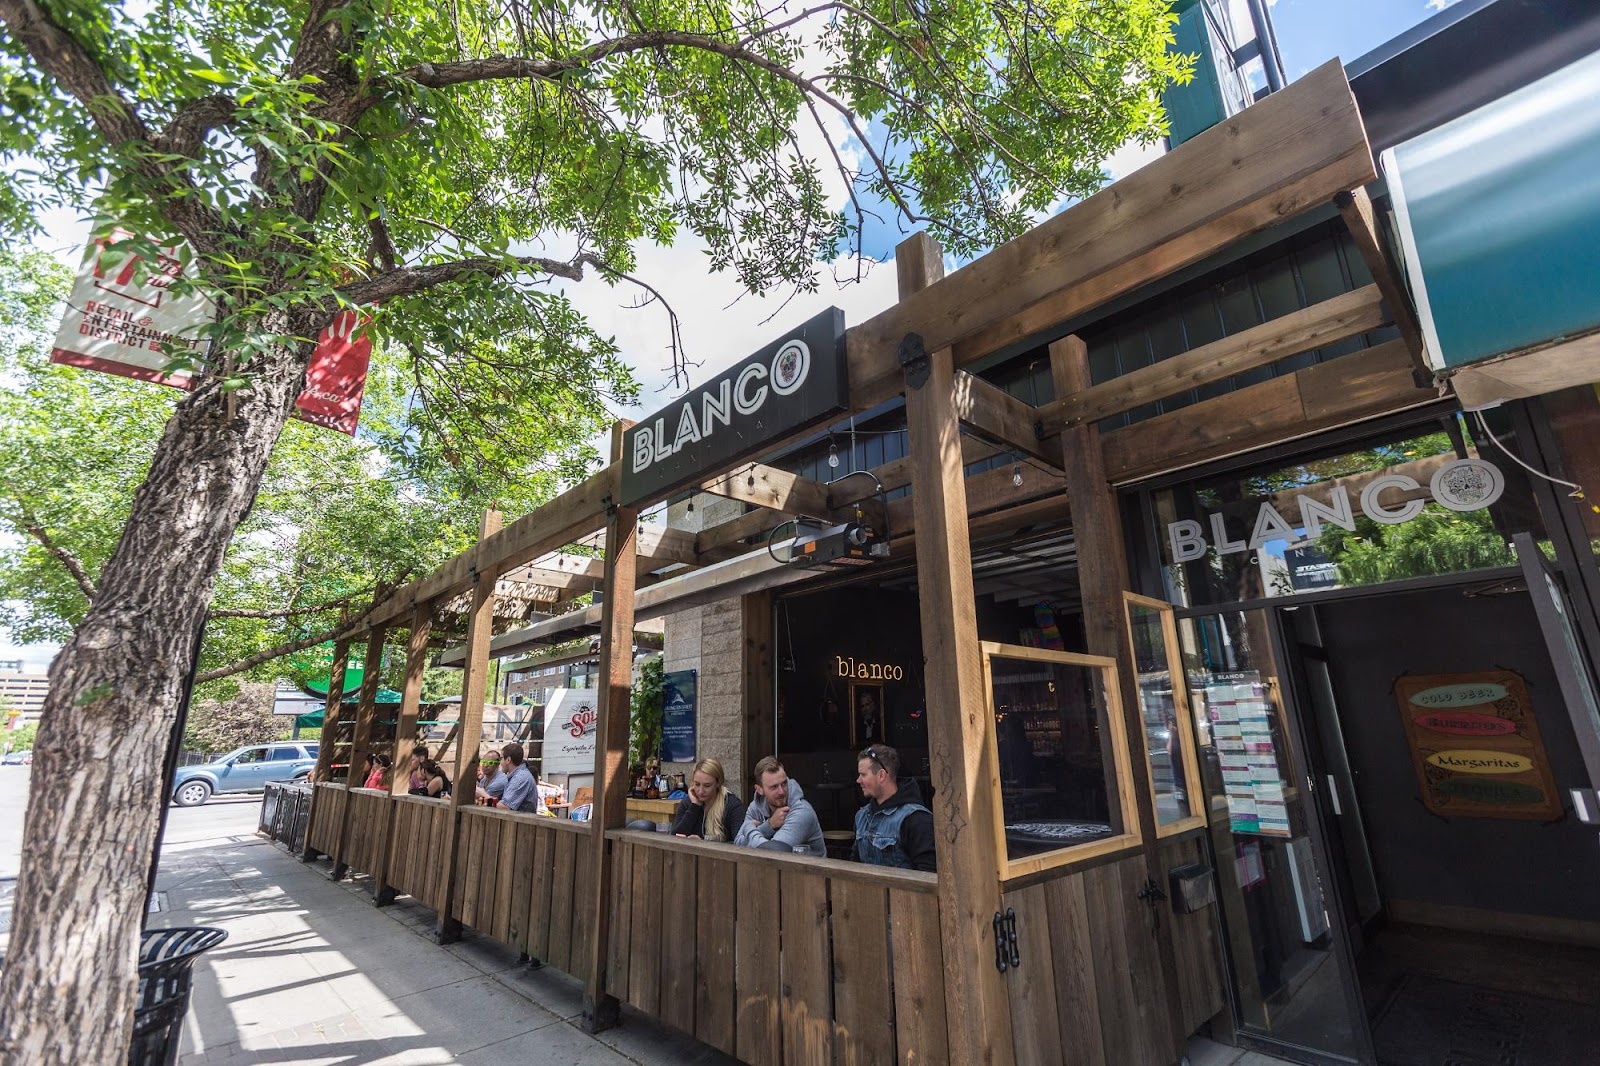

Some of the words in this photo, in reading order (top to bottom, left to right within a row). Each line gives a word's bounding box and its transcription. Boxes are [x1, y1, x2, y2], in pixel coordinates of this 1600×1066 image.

[86, 300, 135, 326] RETAIL
[138, 316, 153, 326] &
[79, 323, 147, 348] DISTRICT
[82, 313, 198, 349] ENTERTAINMNT
[632, 339, 811, 474] BLANCO
[1168, 459, 1505, 563] BLANCO
[836, 655, 903, 680] blanco
[1458, 687, 1496, 700] BEER
[1438, 756, 1520, 768] Margaritas
